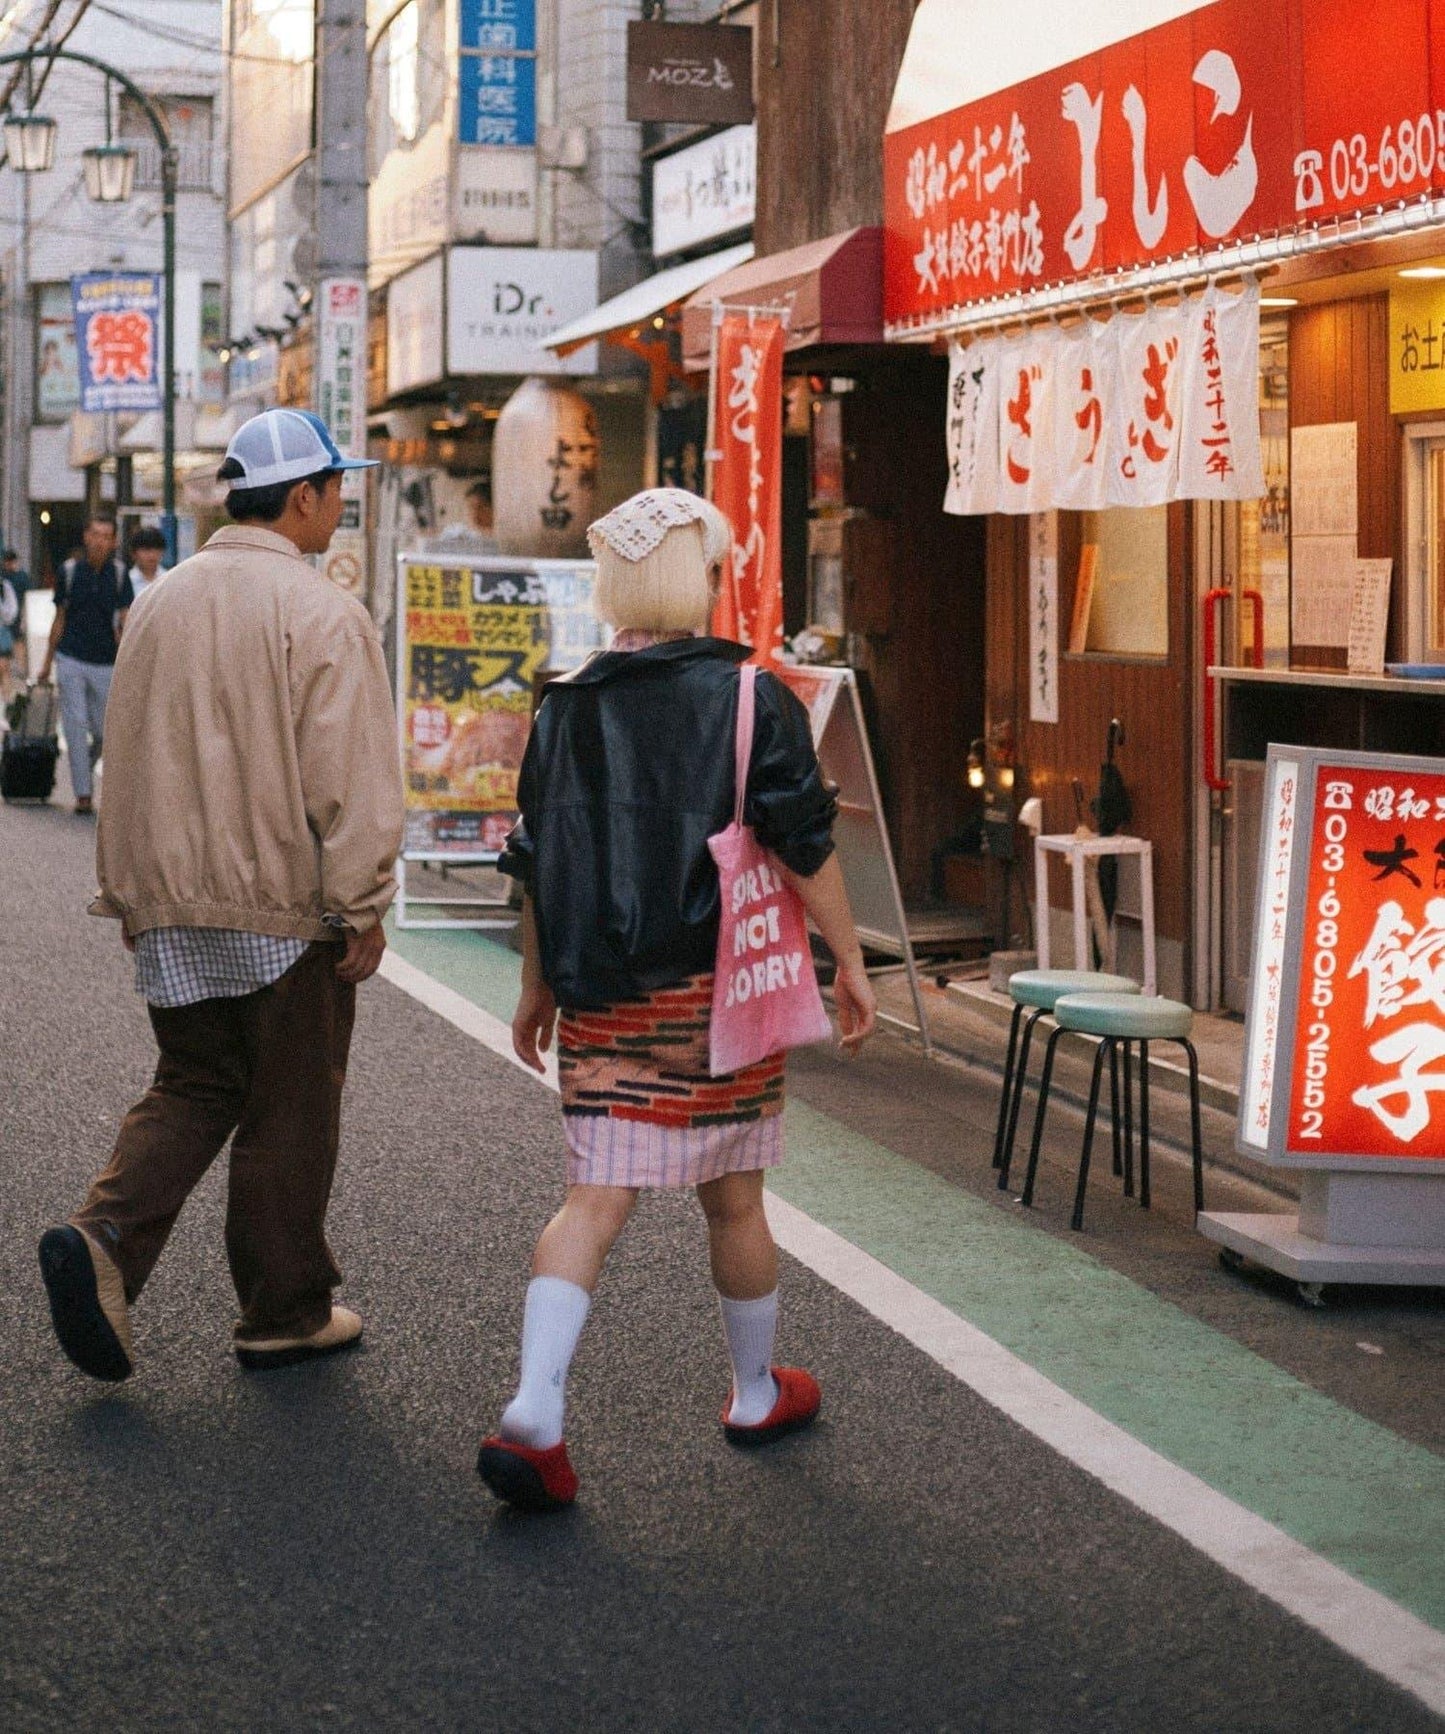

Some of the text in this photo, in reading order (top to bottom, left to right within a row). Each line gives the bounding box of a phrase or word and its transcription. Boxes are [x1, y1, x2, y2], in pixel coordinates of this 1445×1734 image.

[906, 111, 1031, 219] 昭和二十二年
[1062, 49, 1258, 270] よしこ
[93, 315, 147, 376] 祭
[1400, 320, 1445, 373] お土
[1201, 309, 1234, 482] 昭和二十二年
[1363, 834, 1445, 889] 大
[733, 906, 780, 956] NOT
[1300, 814, 1347, 1139] 03-6805-2552
